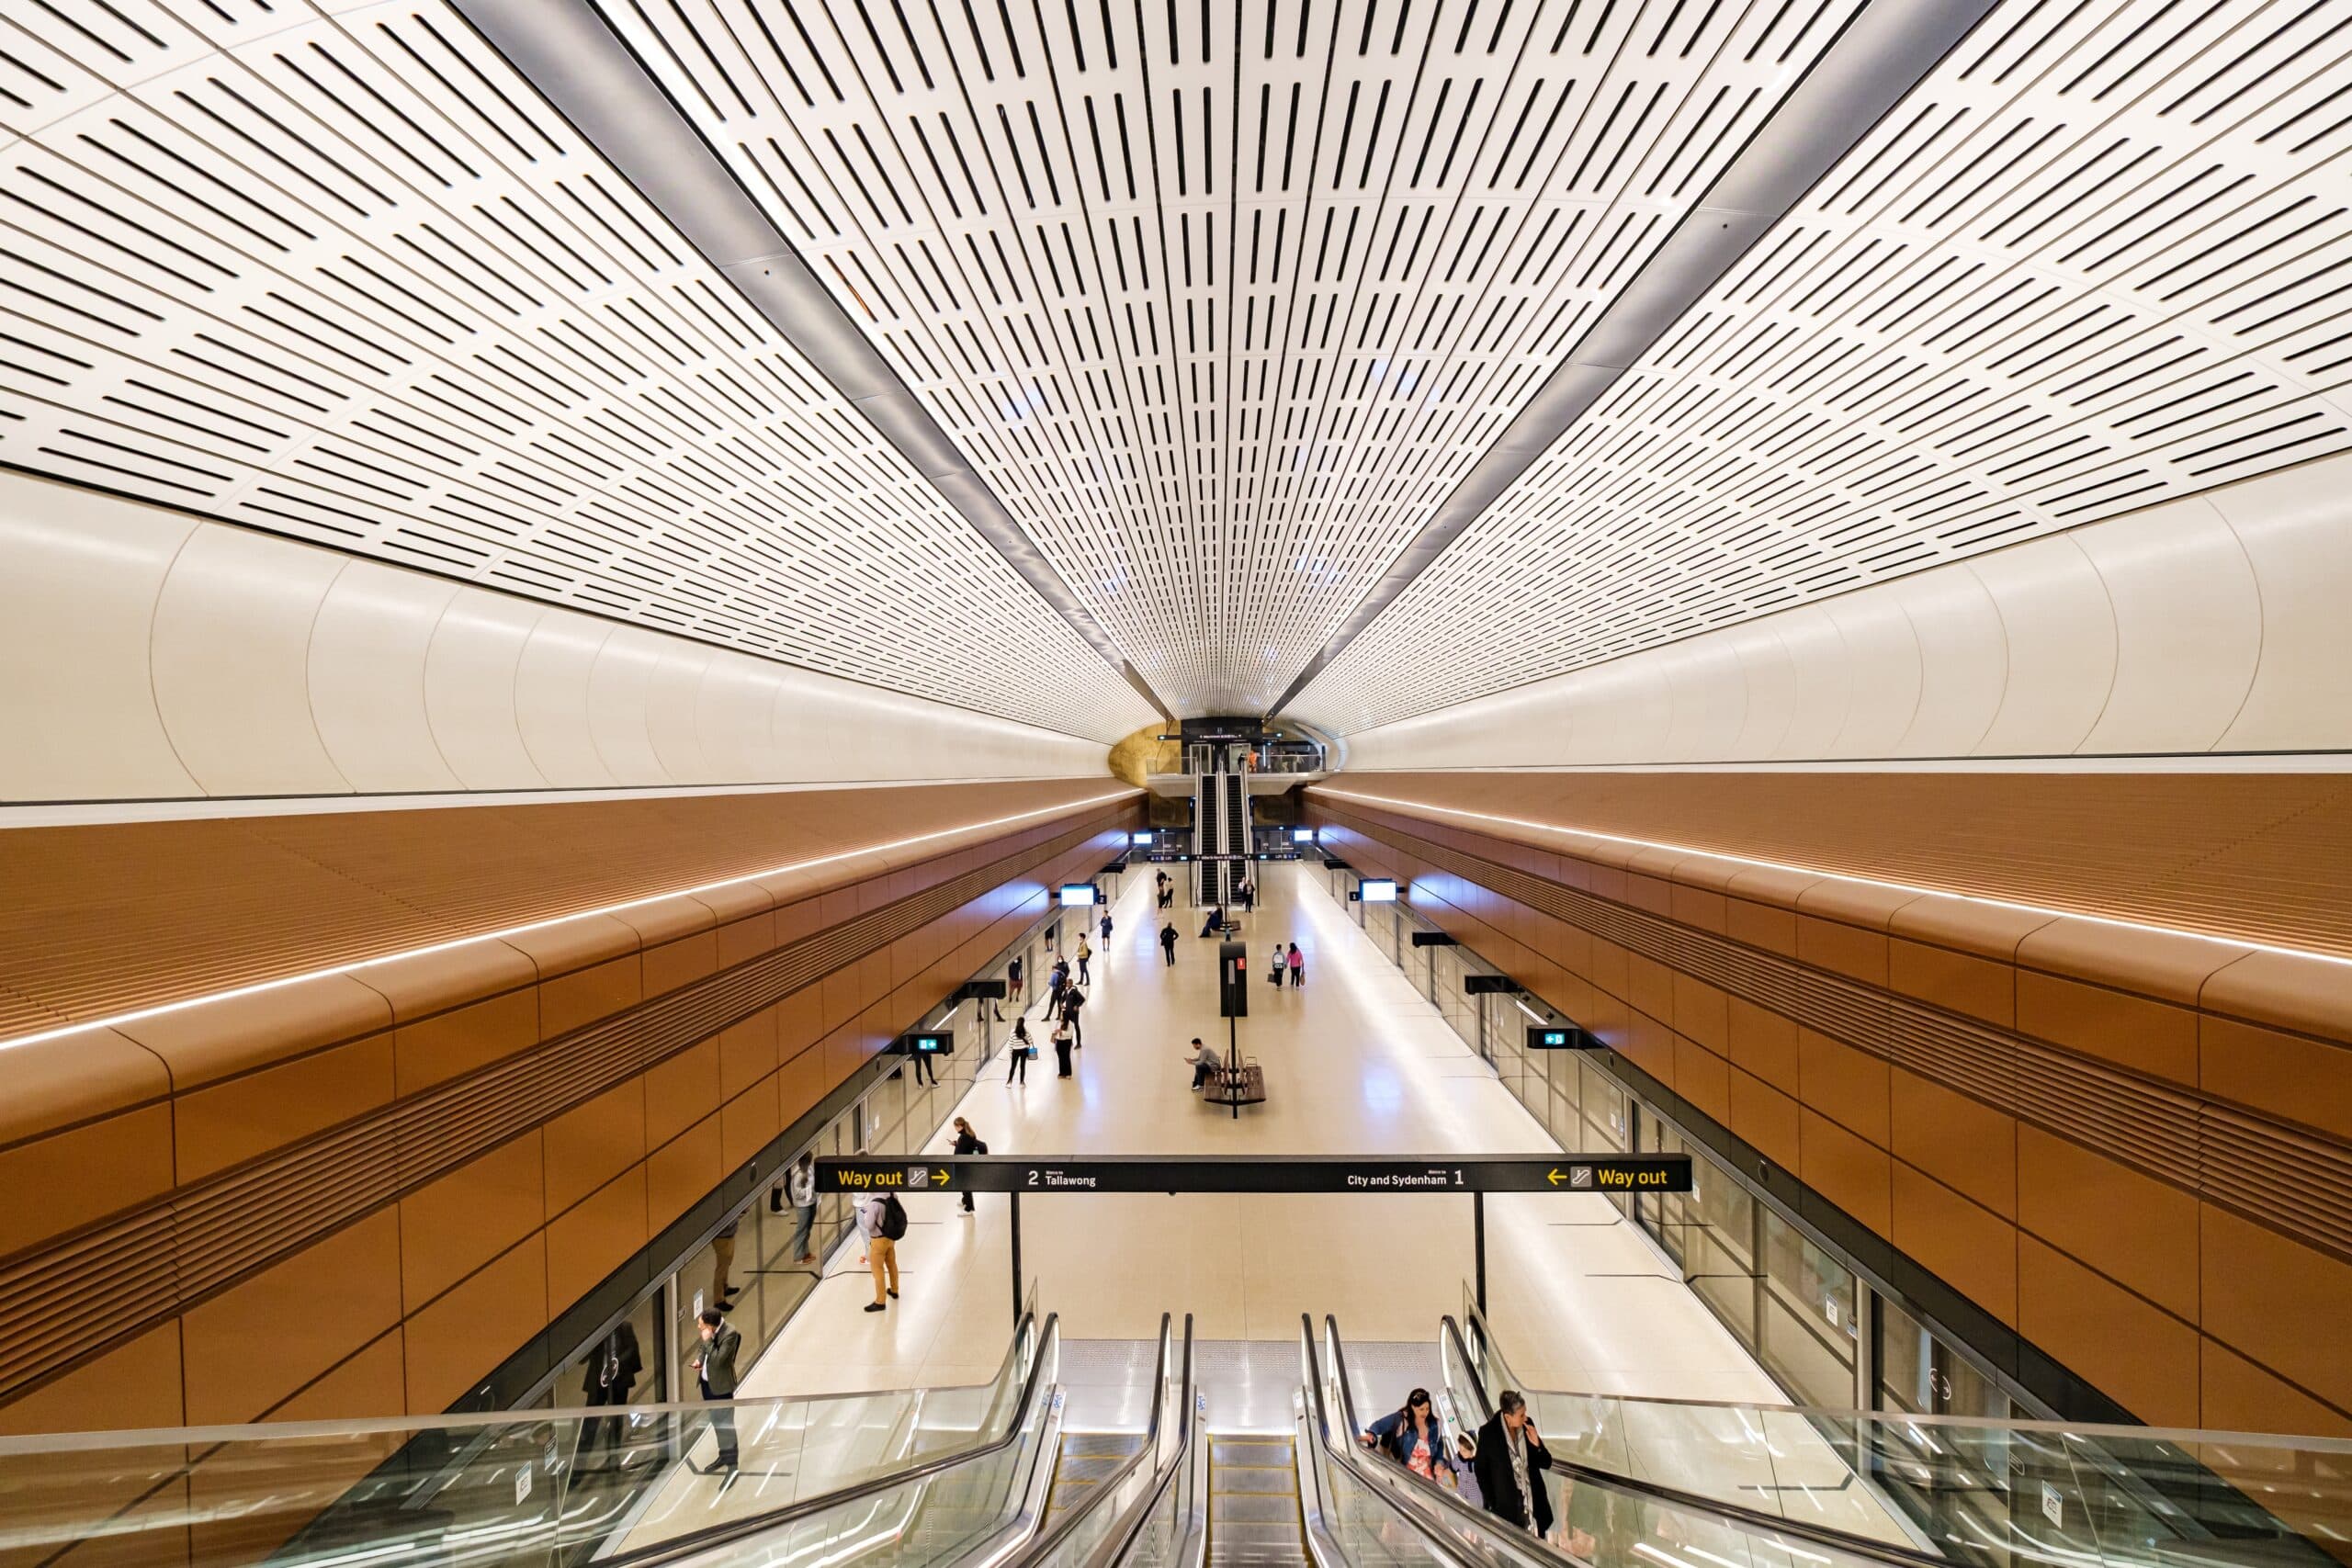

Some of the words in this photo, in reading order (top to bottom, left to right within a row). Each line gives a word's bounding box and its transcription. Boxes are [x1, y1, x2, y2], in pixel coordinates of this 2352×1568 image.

[838, 1169, 872, 1189] Way
[876, 1171, 903, 1185] out
[1028, 1169, 1039, 1186] 2
[1045, 1175, 1096, 1188] Tallawong
[1347, 1175, 1368, 1188] City
[1370, 1175, 1390, 1185] and
[1392, 1175, 1447, 1188] Sydenham
[1454, 1169, 1464, 1185] 1
[1598, 1168, 1634, 1188] Way
[1638, 1170, 1668, 1185] out
